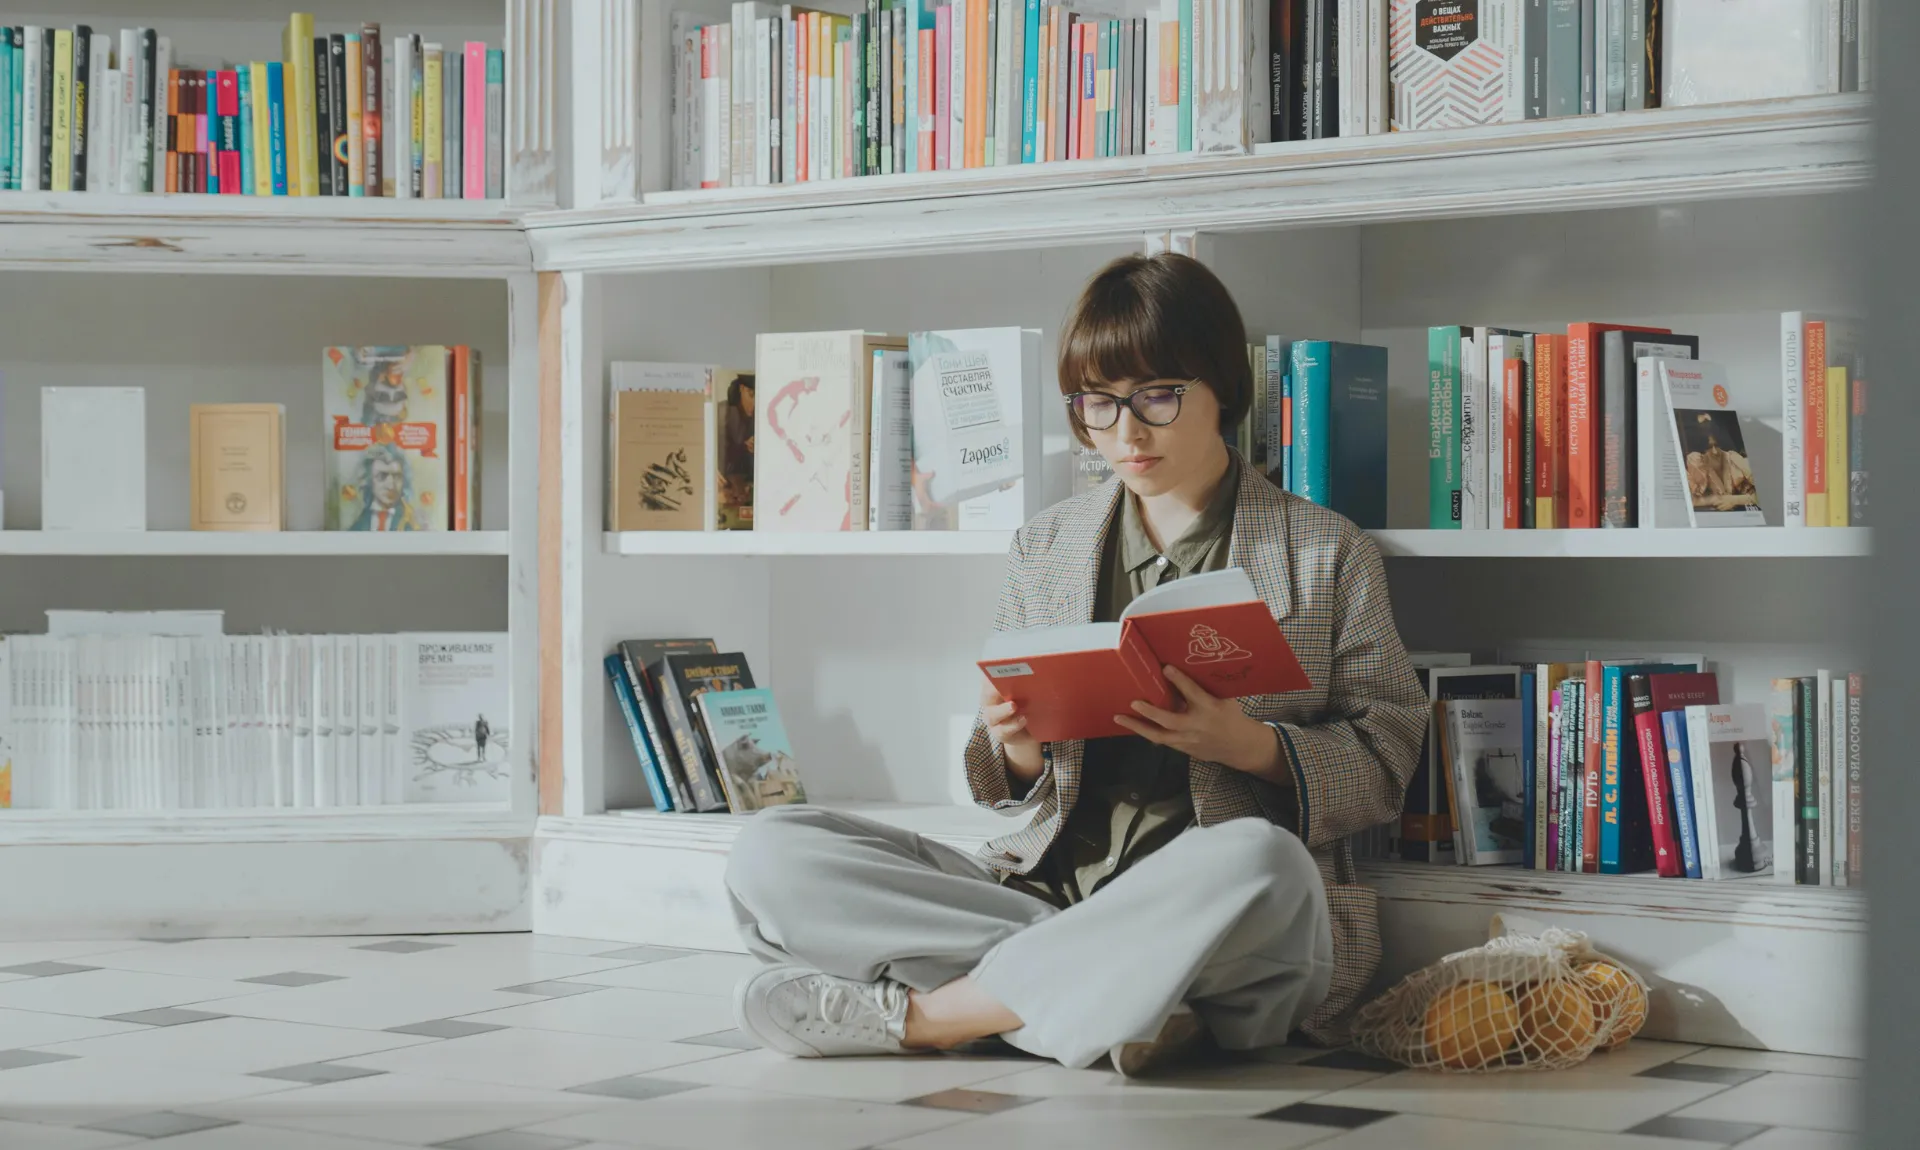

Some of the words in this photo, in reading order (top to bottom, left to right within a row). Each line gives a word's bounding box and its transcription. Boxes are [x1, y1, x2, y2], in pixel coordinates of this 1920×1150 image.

[1420, 13, 1474, 28] ДЕЙСТВИТЕЛЬНО
[1432, 8, 1438, 16] О
[1438, 6, 1462, 16] ВЕЩАХ
[1432, 23, 1462, 33] ВАЖНЫХ
[1273, 53, 1282, 83] КАНТОР
[938, 357, 962, 370] Тони
[964, 353, 989, 368] Шей
[1787, 330, 1798, 374] ТОЛПЫ
[941, 370, 992, 388] ДОСТАВЛЯЯ
[1570, 338, 1578, 399] БУДДИЗМА
[943, 381, 993, 397] счастье
[1268, 369, 1280, 414] НЕЧАЯННЫЙ
[1787, 377, 1798, 394] ИЗ
[1430, 370, 1441, 458] Блаженные
[1442, 378, 1453, 434] похабы
[1787, 398, 1798, 432] УЙТИ
[1464, 394, 1473, 452] СЕКТАНТЫ
[1571, 403, 1579, 456] ИСТОРИЯ
[959, 443, 1003, 465] Zappos
[1079, 460, 1113, 472] ИСТОРИ
[853, 452, 862, 506] STRELKA
[418, 643, 495, 654] ПРОЖИВАЕМОЕ
[418, 654, 454, 664] ВРЕМЯ
[1668, 692, 1685, 700] МАКС
[1461, 709, 1484, 719] Balzac
[1851, 697, 1860, 781] ФИЛОСОФИЯ
[1604, 728, 1617, 784] КЛЕЙН
[1805, 722, 1813, 795] МУСУЛЬМАНСКОМУ
[1587, 771, 1598, 808] ПУТЬ
[1605, 788, 1617, 803] С.
[1652, 769, 1664, 825] КОНФУЦИАНСТВО
[1850, 785, 1860, 794] И
[1606, 807, 1617, 824] Л.
[1851, 798, 1860, 833] СЕКС
[1807, 828, 1815, 854] Нортон
